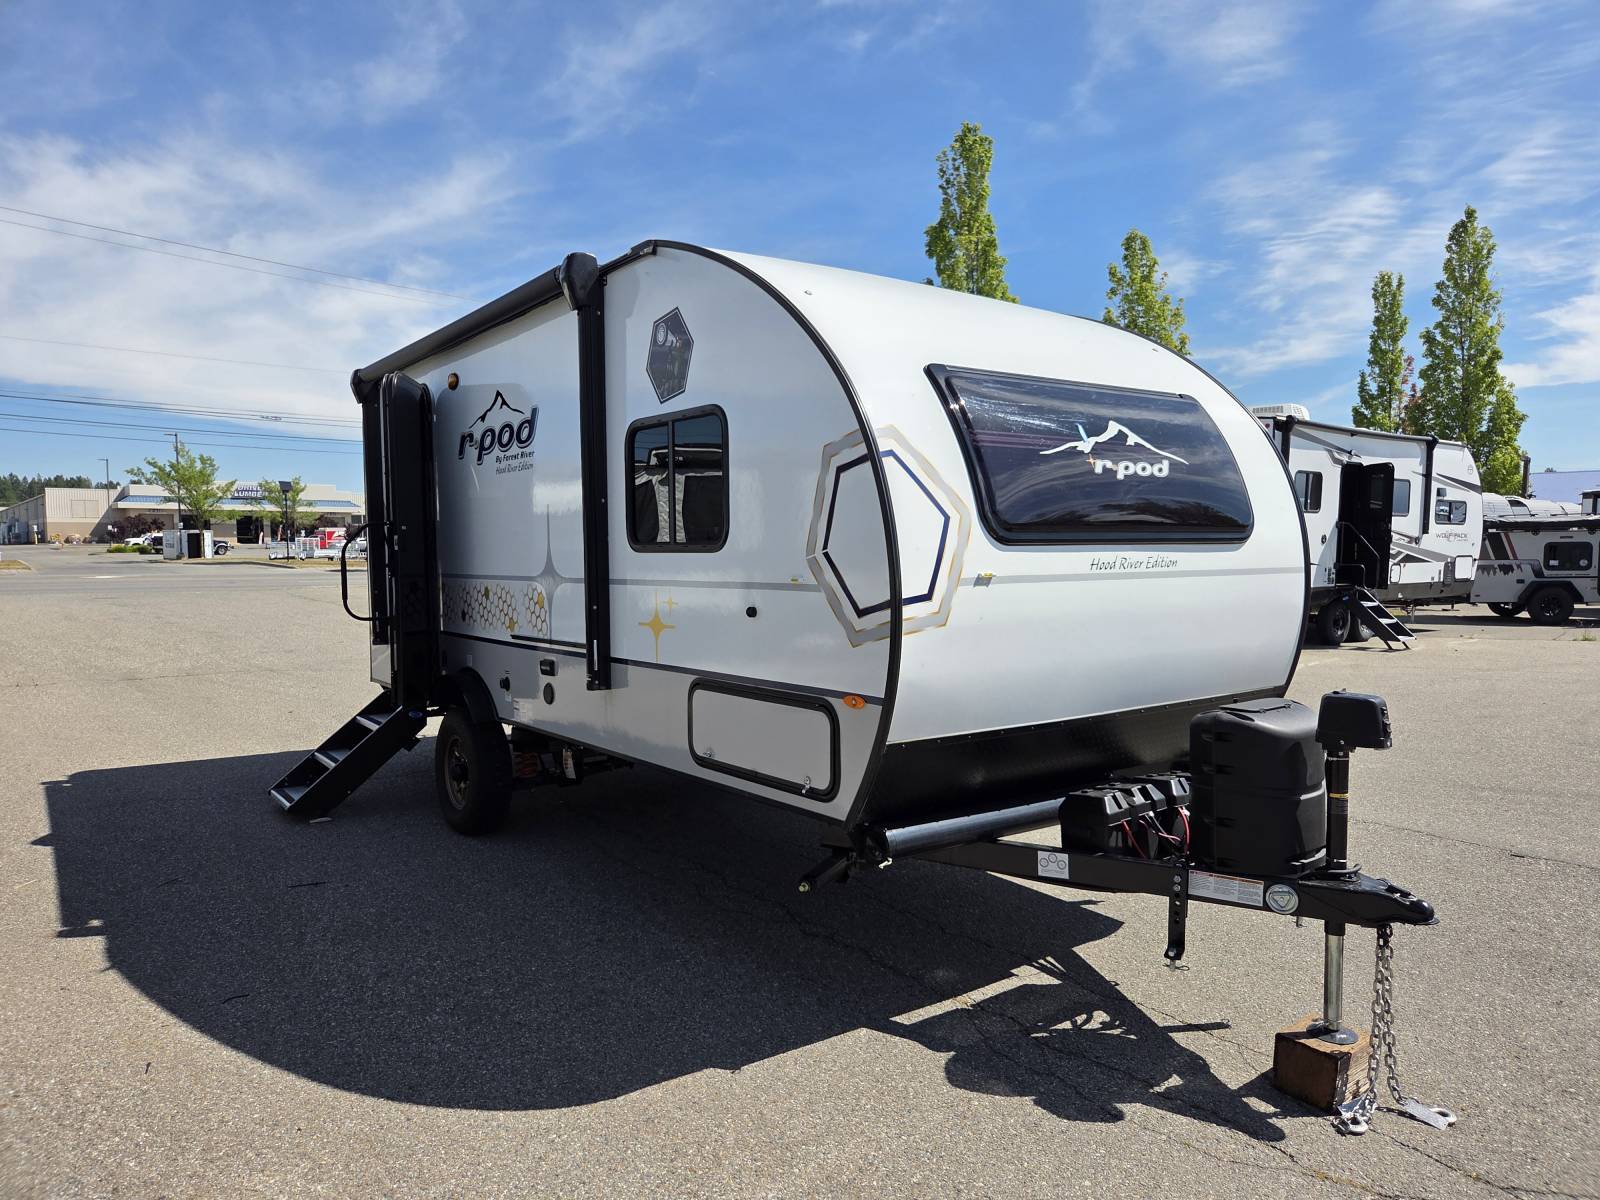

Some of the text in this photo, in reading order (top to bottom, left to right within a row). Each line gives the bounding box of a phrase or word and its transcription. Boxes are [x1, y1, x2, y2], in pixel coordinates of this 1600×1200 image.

[1090, 554, 1178, 571] Hood River Edition
